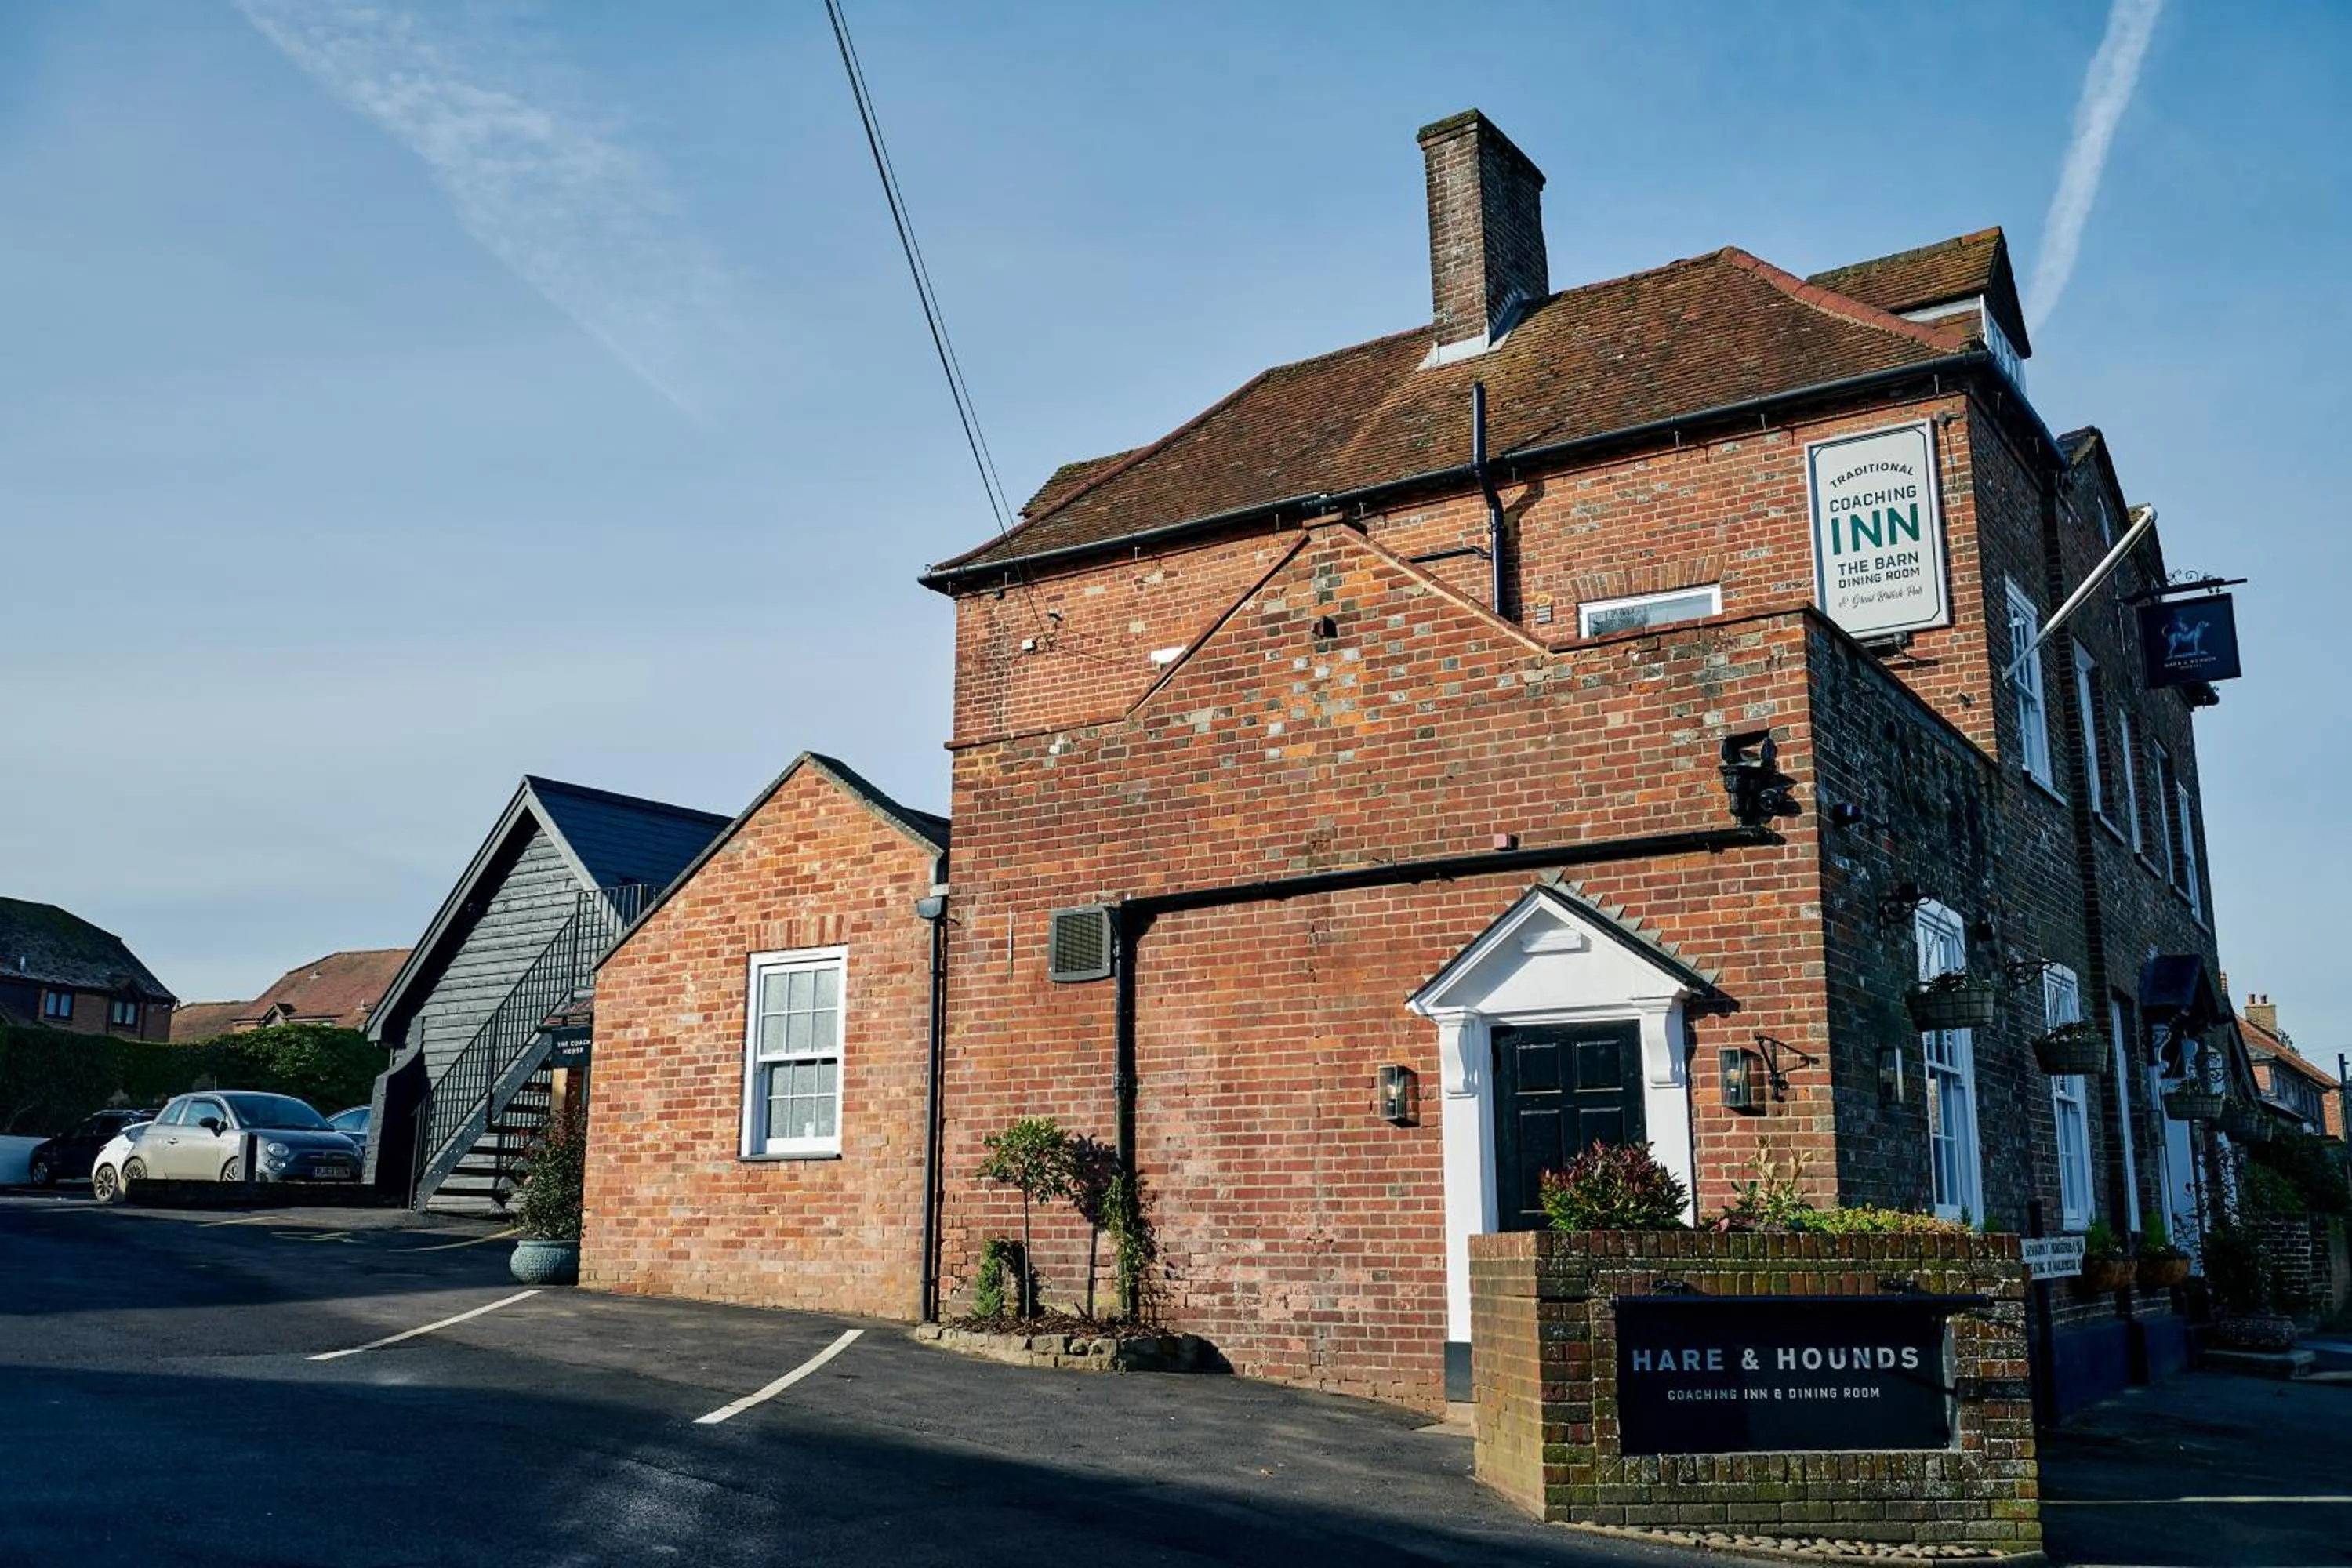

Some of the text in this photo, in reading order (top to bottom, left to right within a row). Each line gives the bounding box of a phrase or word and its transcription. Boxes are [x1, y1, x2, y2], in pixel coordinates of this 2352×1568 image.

[1829, 462, 1914, 488] TRADITIONAL
[1829, 485, 1917, 512] COACHING
[1831, 503, 1920, 555] INN
[1838, 551, 1919, 575] THE BARN
[1838, 567, 1920, 589] DINING ROOM
[1632, 1346, 1919, 1372] HARE & HOUNDS
[1668, 1387, 1880, 1401] COACHING INN & DINING ROOM
